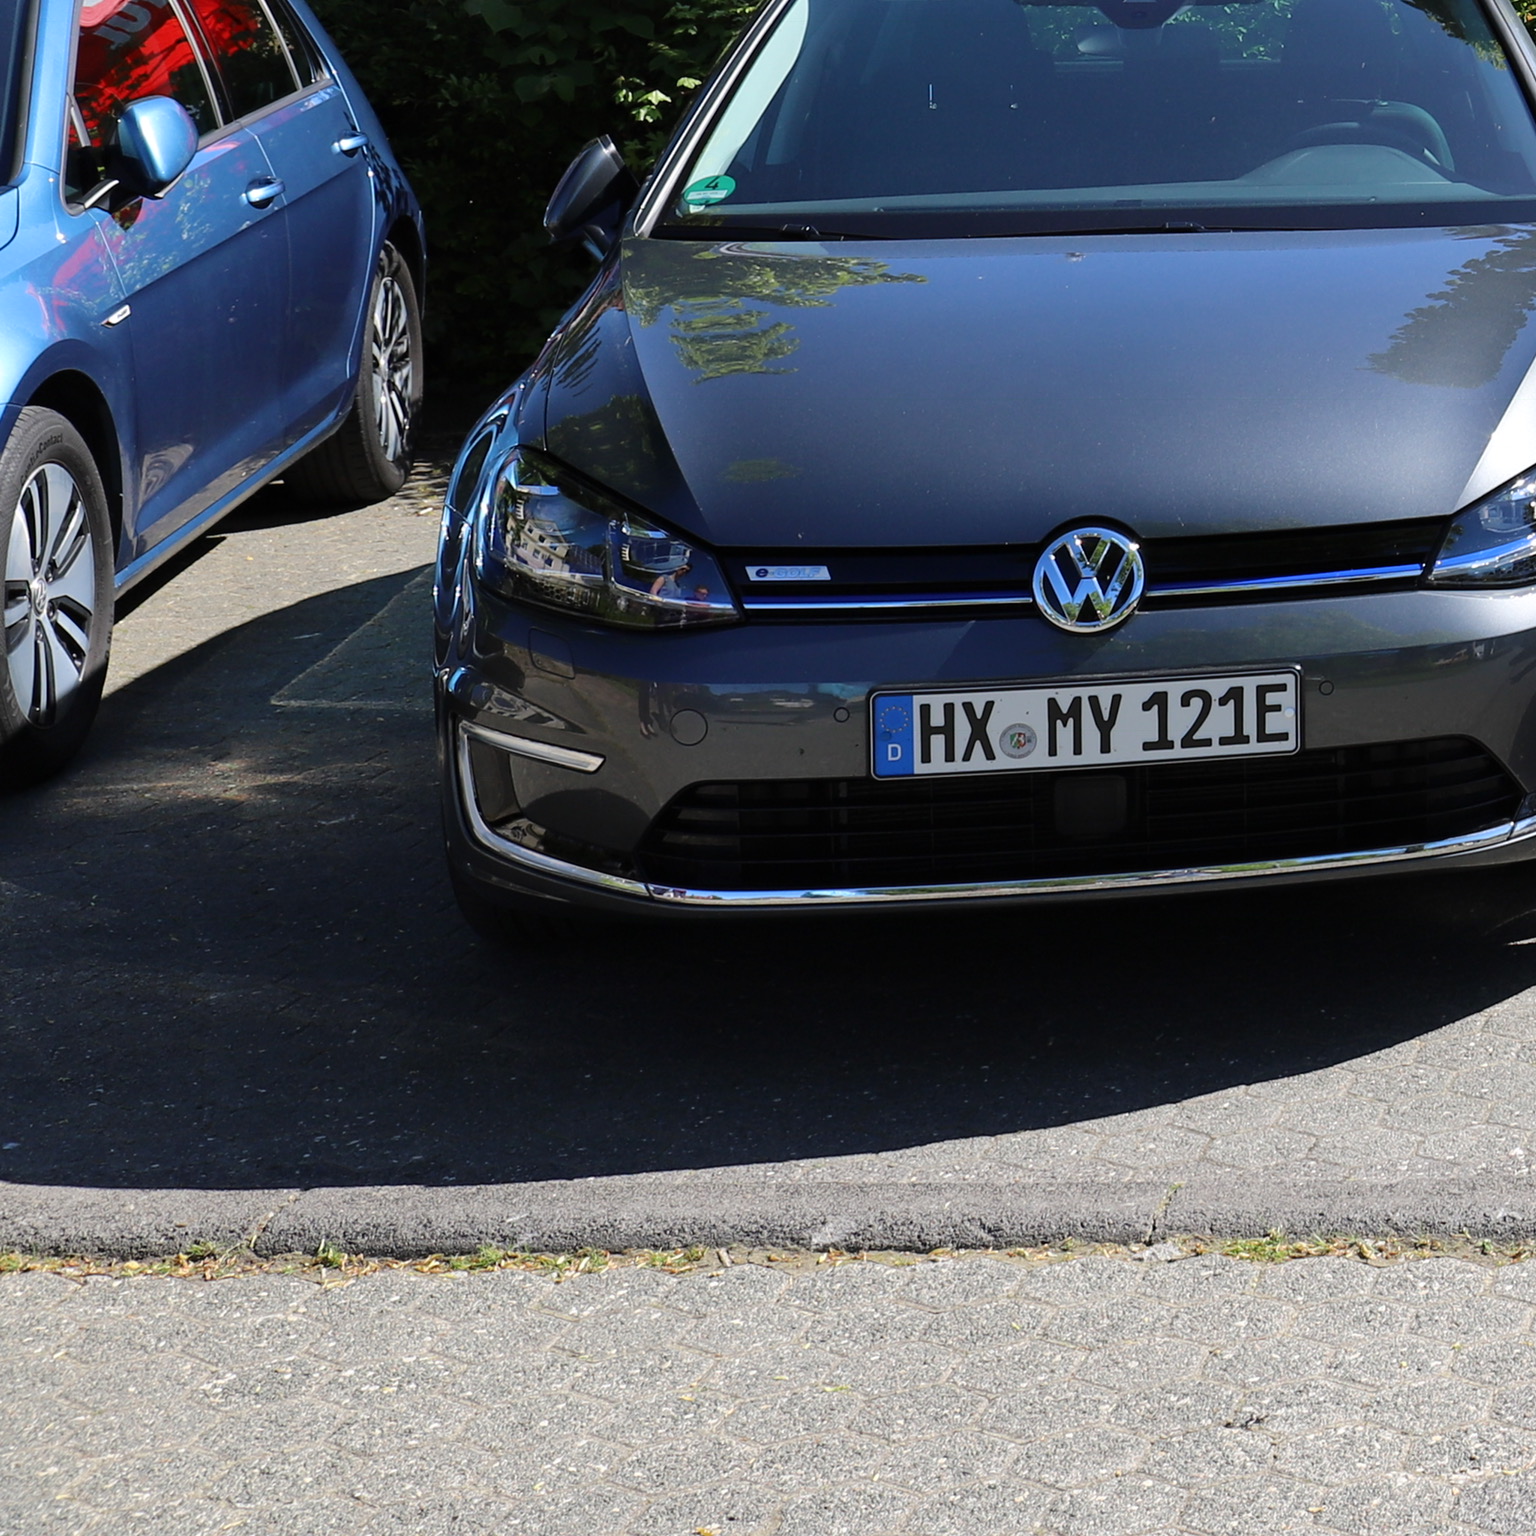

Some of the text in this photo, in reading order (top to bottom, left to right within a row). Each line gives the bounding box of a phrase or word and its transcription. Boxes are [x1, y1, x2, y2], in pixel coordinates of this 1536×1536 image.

[704, 176, 720, 190] 4
[919, 700, 996, 764] HX
[1047, 693, 1122, 757] MY
[1141, 682, 1290, 752] 121E
[887, 744, 902, 761] D
